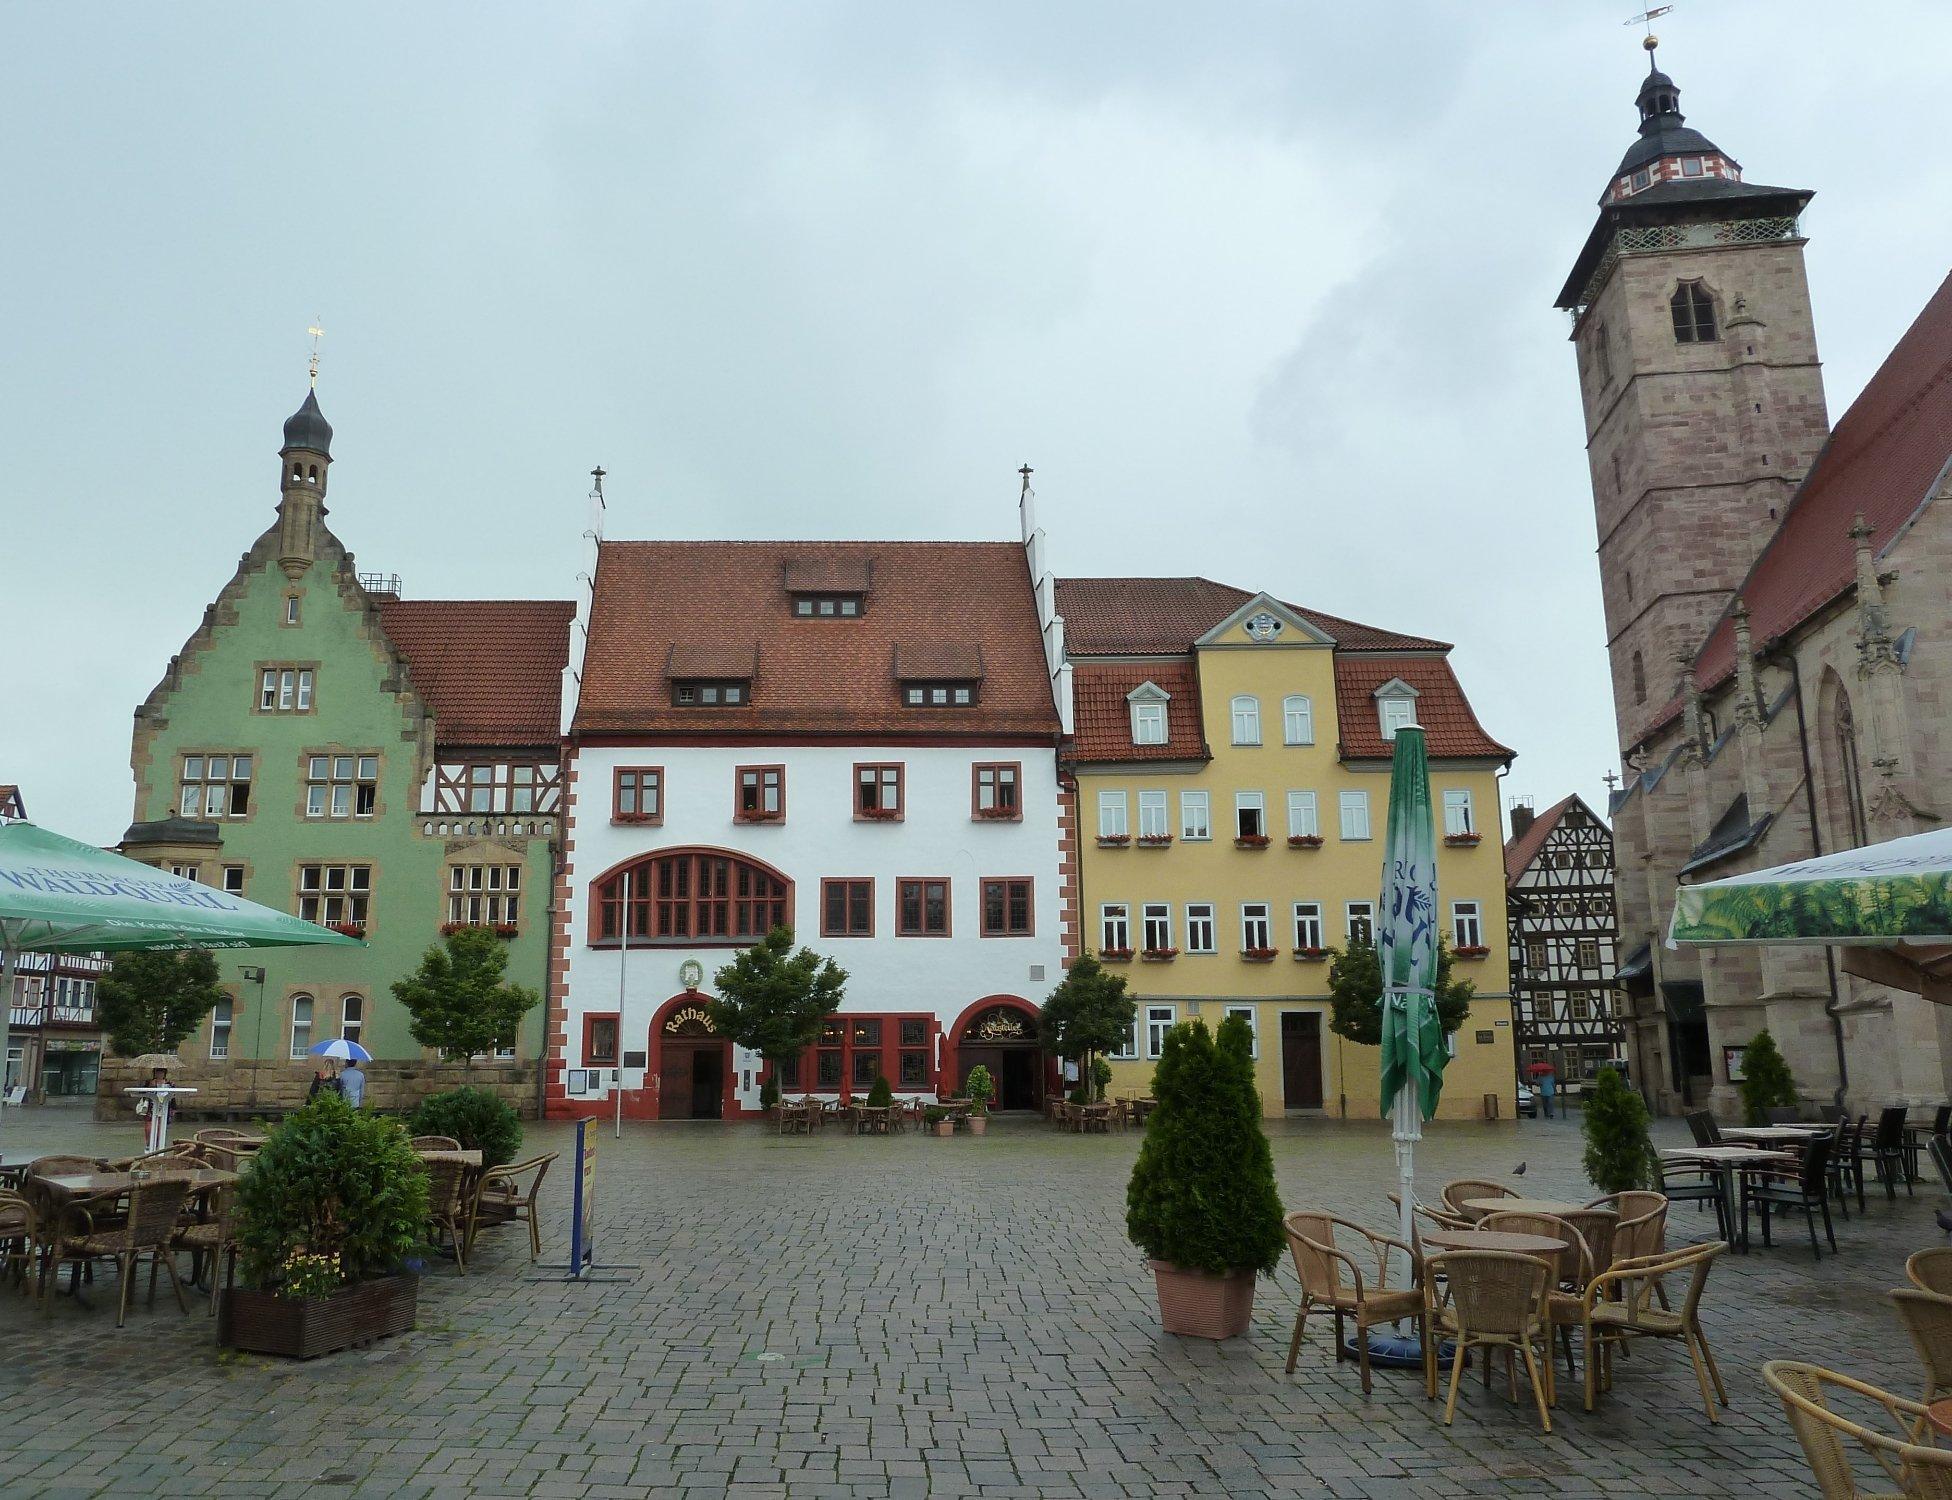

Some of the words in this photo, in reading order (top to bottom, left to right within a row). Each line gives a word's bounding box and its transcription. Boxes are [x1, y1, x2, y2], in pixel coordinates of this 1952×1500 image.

[105, 919, 136, 928] Die
[136, 920, 180, 930] Kraft
[665, 1007, 717, 1033] Rathaus
